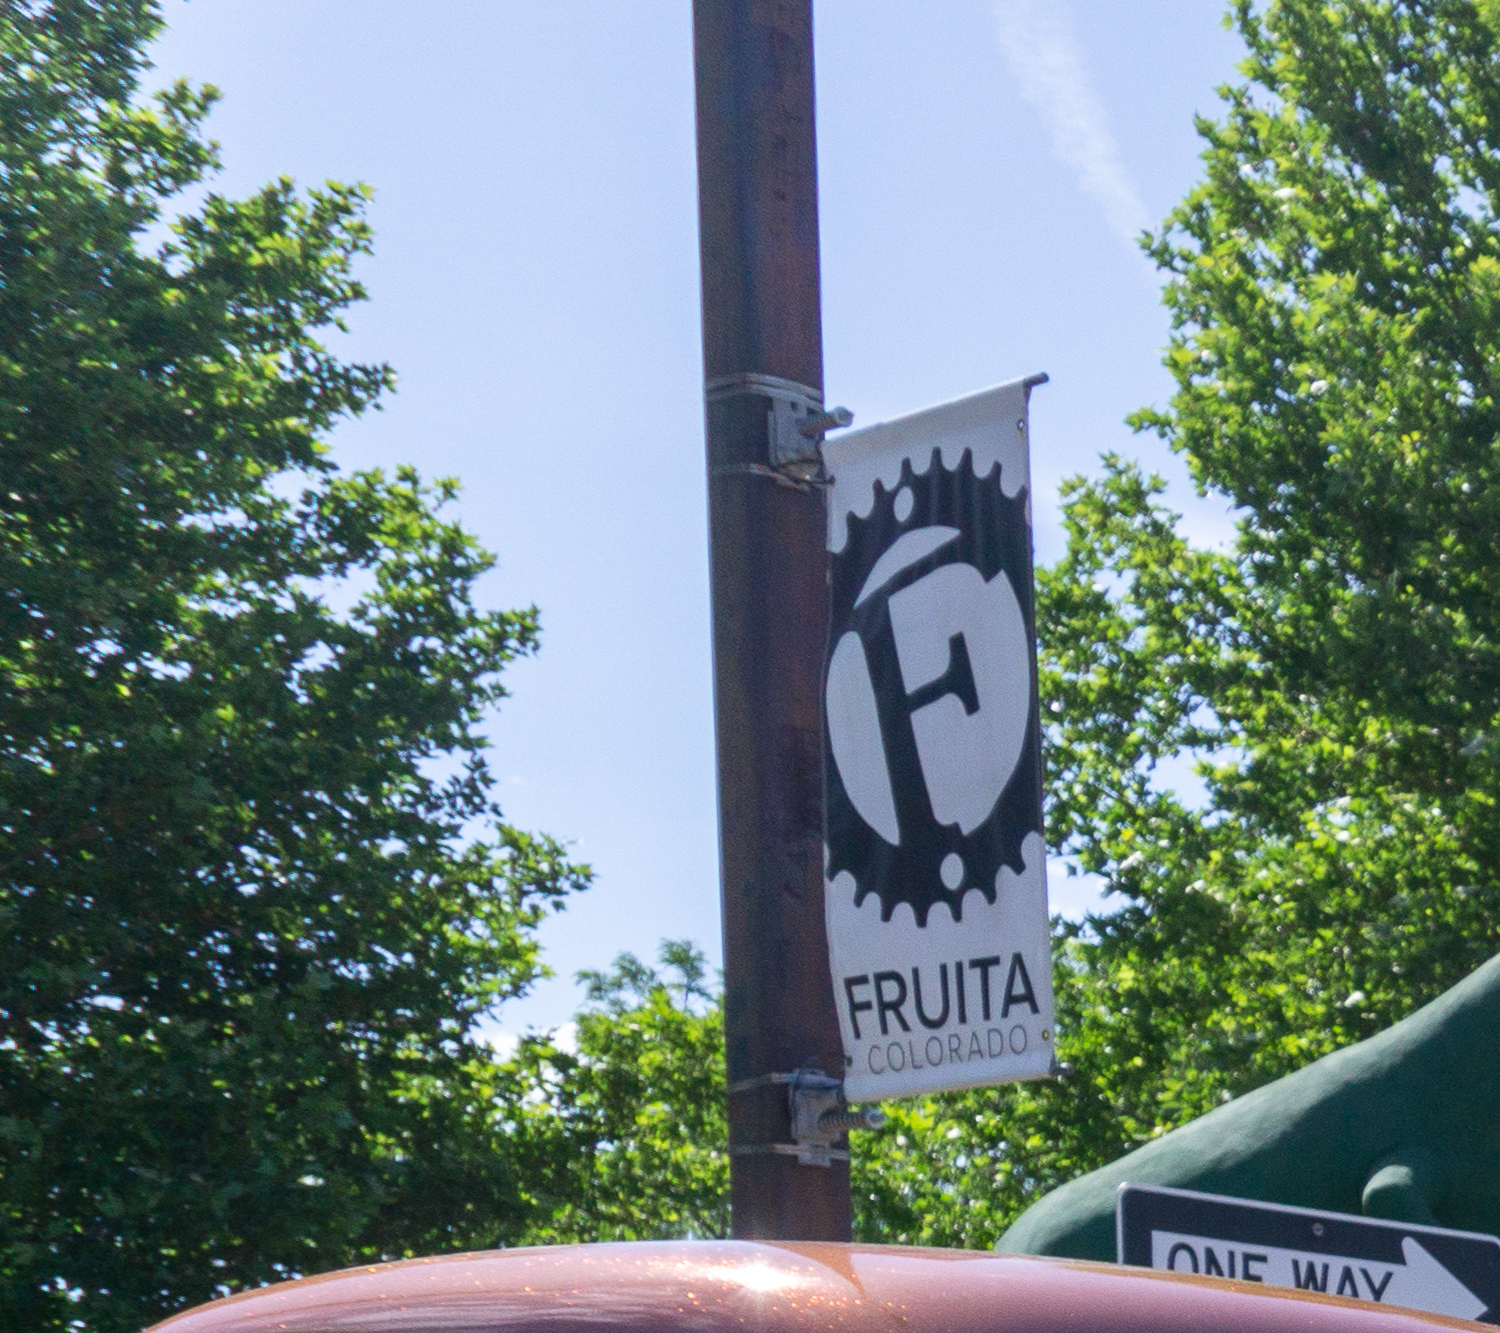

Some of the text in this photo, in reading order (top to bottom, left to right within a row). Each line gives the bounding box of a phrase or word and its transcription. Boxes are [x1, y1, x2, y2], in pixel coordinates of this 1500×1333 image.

[844, 951, 1040, 1040] FRUITA
[868, 1024, 1028, 1075] COLORADO
[1167, 1242, 1394, 1302] ONE WAY
